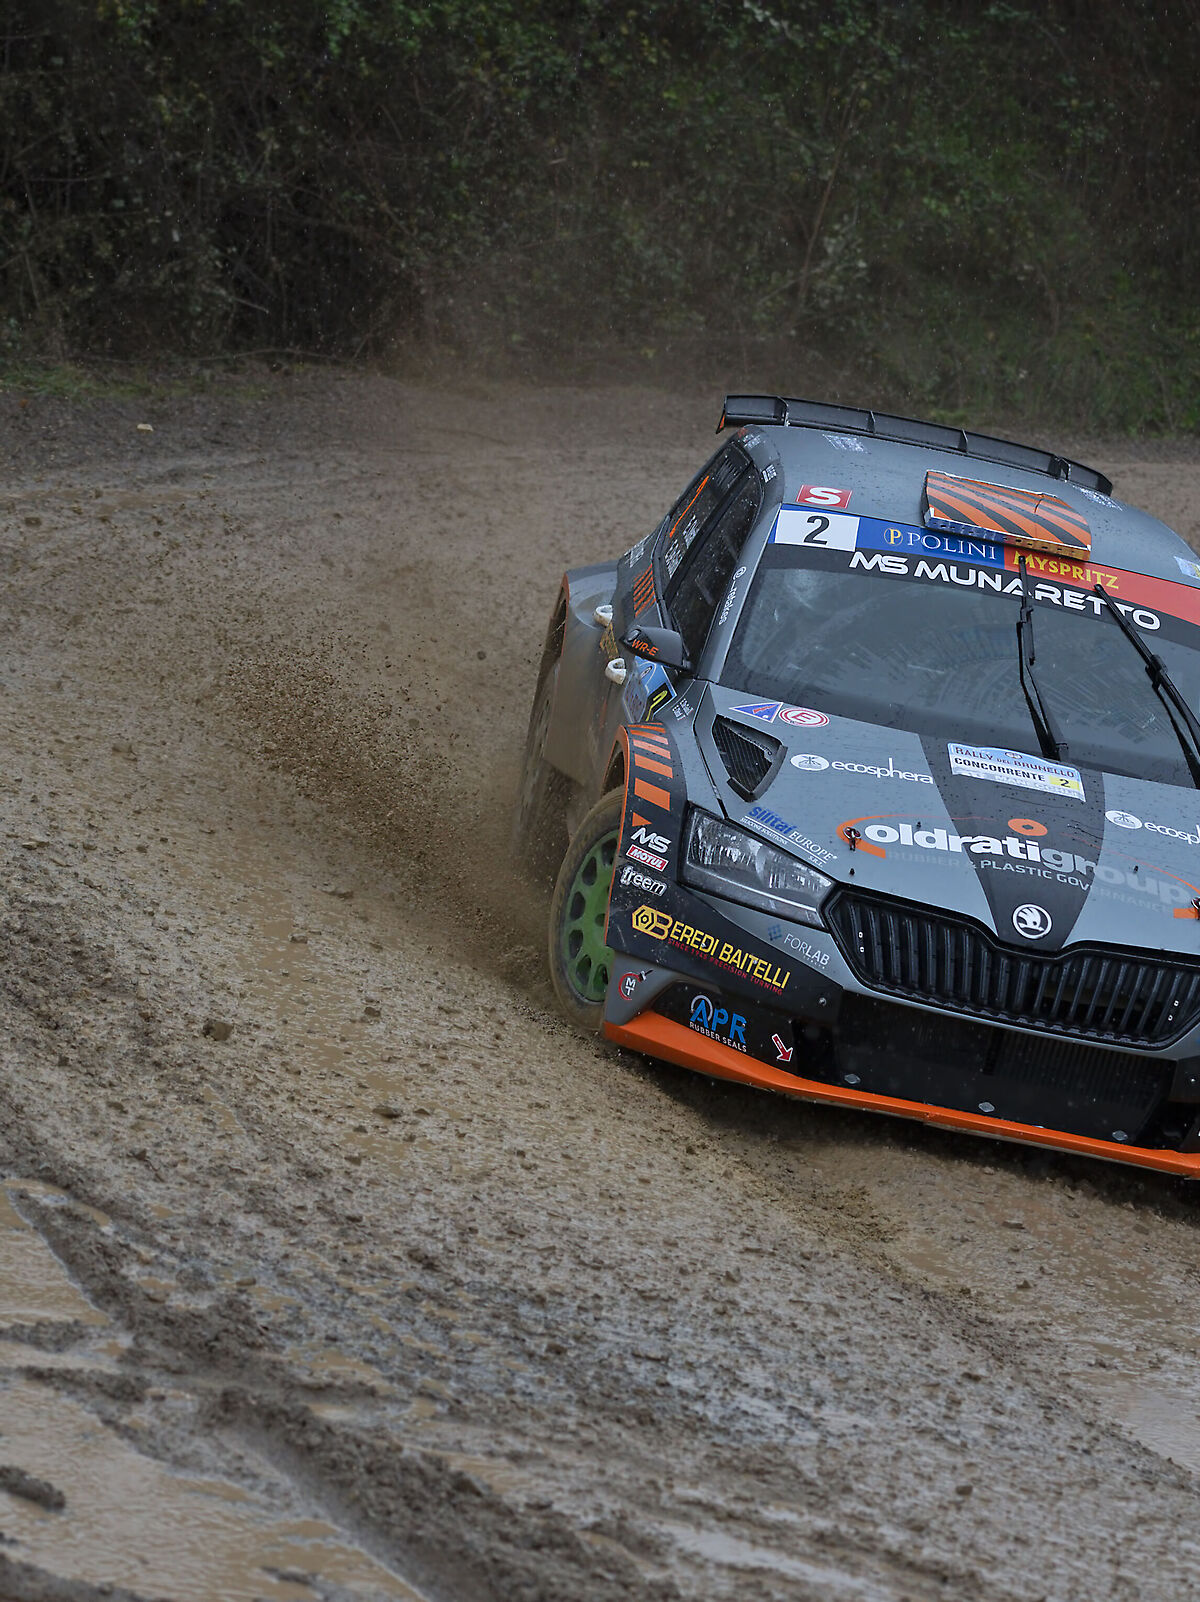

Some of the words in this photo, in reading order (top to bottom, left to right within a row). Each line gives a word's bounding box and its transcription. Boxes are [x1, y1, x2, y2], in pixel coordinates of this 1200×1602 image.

[804, 516, 830, 545] 2
[908, 532, 996, 560] POLINI
[1014, 551, 1119, 589] MYSPRITZ
[849, 552, 908, 574] MS
[914, 560, 1160, 630] MUNARETTO
[632, 639, 658, 656] WR-E
[832, 758, 934, 784] ecosphera
[954, 747, 993, 760] RALLY
[1014, 761, 1074, 778] BRUNELLO
[954, 758, 1046, 782] CONCORRENTE
[1060, 778, 1070, 788] 2
[748, 806, 798, 834] silital
[631, 828, 672, 853] MS
[630, 848, 664, 868] MOTUL
[865, 819, 1192, 904] oldratigroup
[888, 852, 959, 867] RUBBER
[980, 859, 1052, 880] PLASTIC
[620, 866, 667, 896] freem
[670, 921, 720, 956] EREDI
[719, 942, 790, 989] BAITELLI
[784, 933, 830, 966] FORLAB
[709, 956, 747, 979] PRECISION
[751, 976, 782, 995] TURNING
[690, 999, 747, 1044] APR
[690, 1021, 720, 1042] RUBBER
[722, 1036, 747, 1052] SEALS
